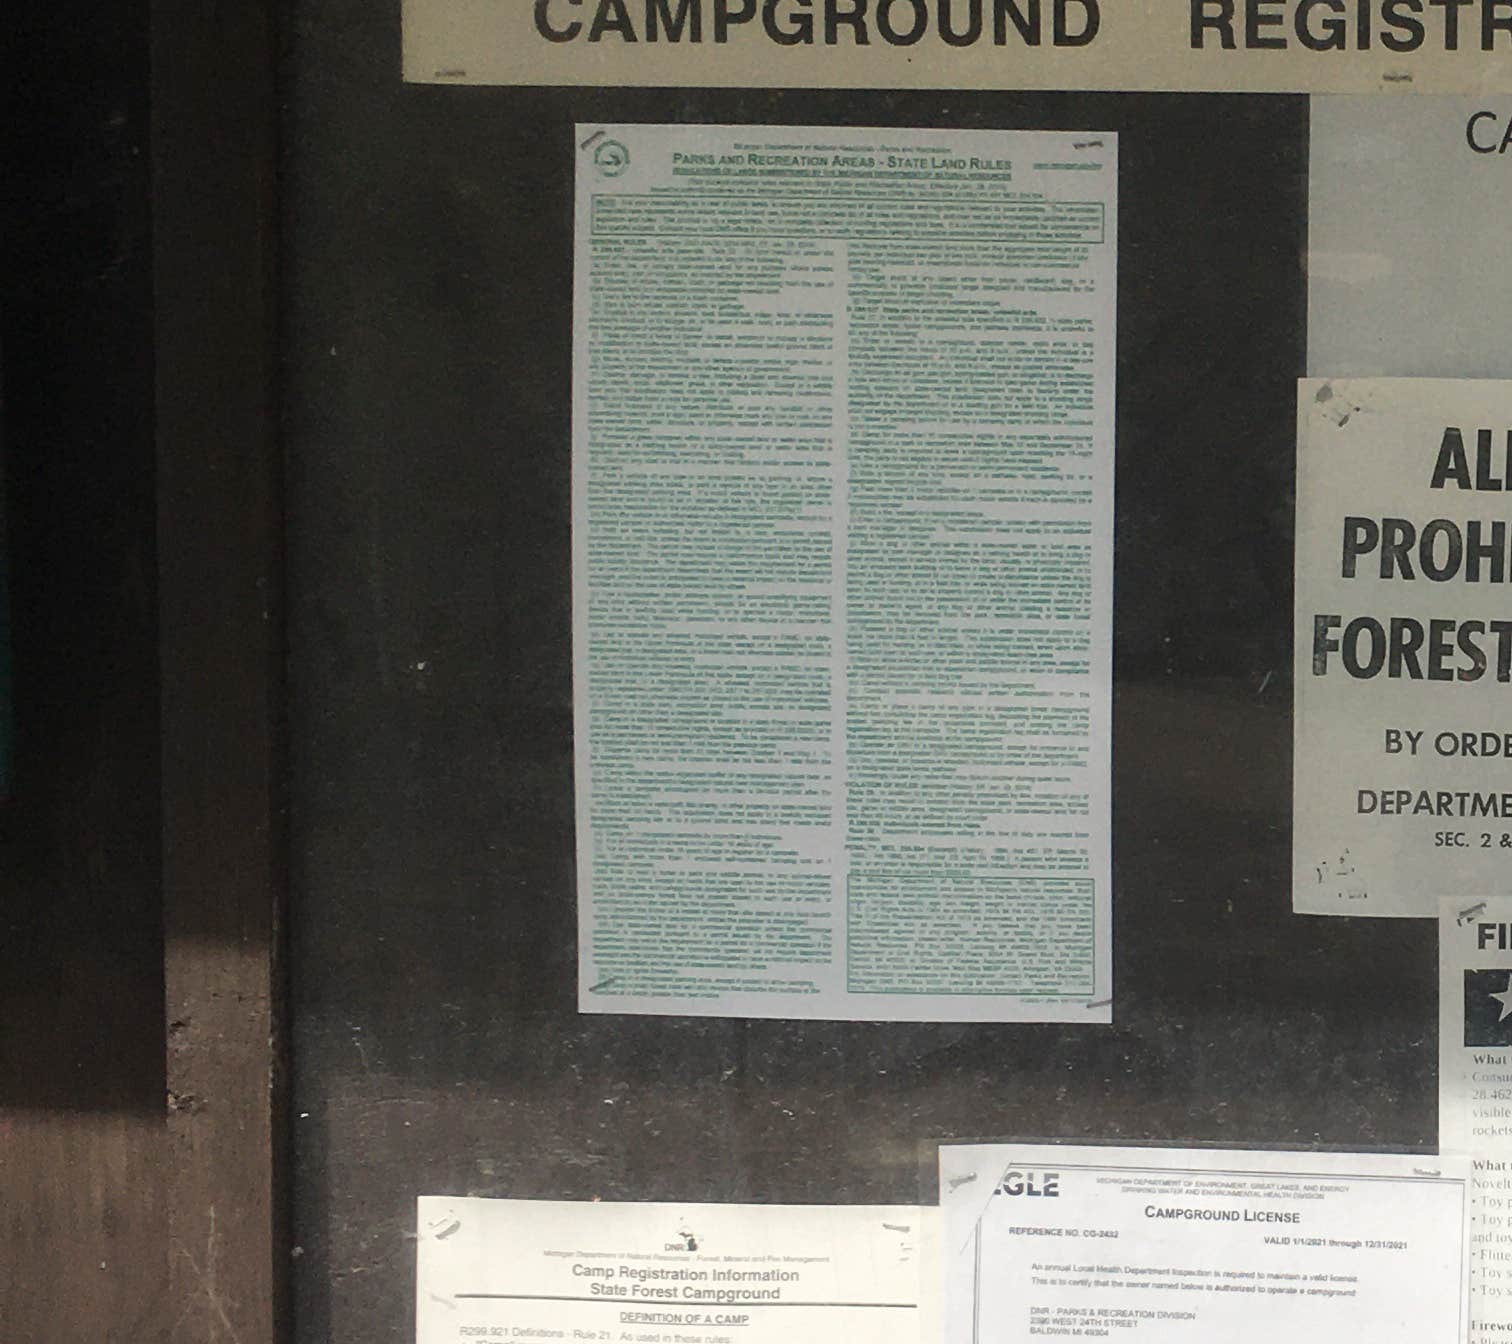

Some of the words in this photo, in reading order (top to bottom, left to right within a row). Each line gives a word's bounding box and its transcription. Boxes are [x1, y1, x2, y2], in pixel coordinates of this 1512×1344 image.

[1144, 1205, 1240, 1221] CAMPGROUND
[1243, 1208, 1300, 1223] LICENSE
[571, 1263, 615, 1280] Camp
[618, 1265, 708, 1282] Registration
[712, 1268, 800, 1281] Information
[590, 1282, 628, 1300] State
[631, 1283, 678, 1300] Forest
[681, 1285, 780, 1302] Campground
